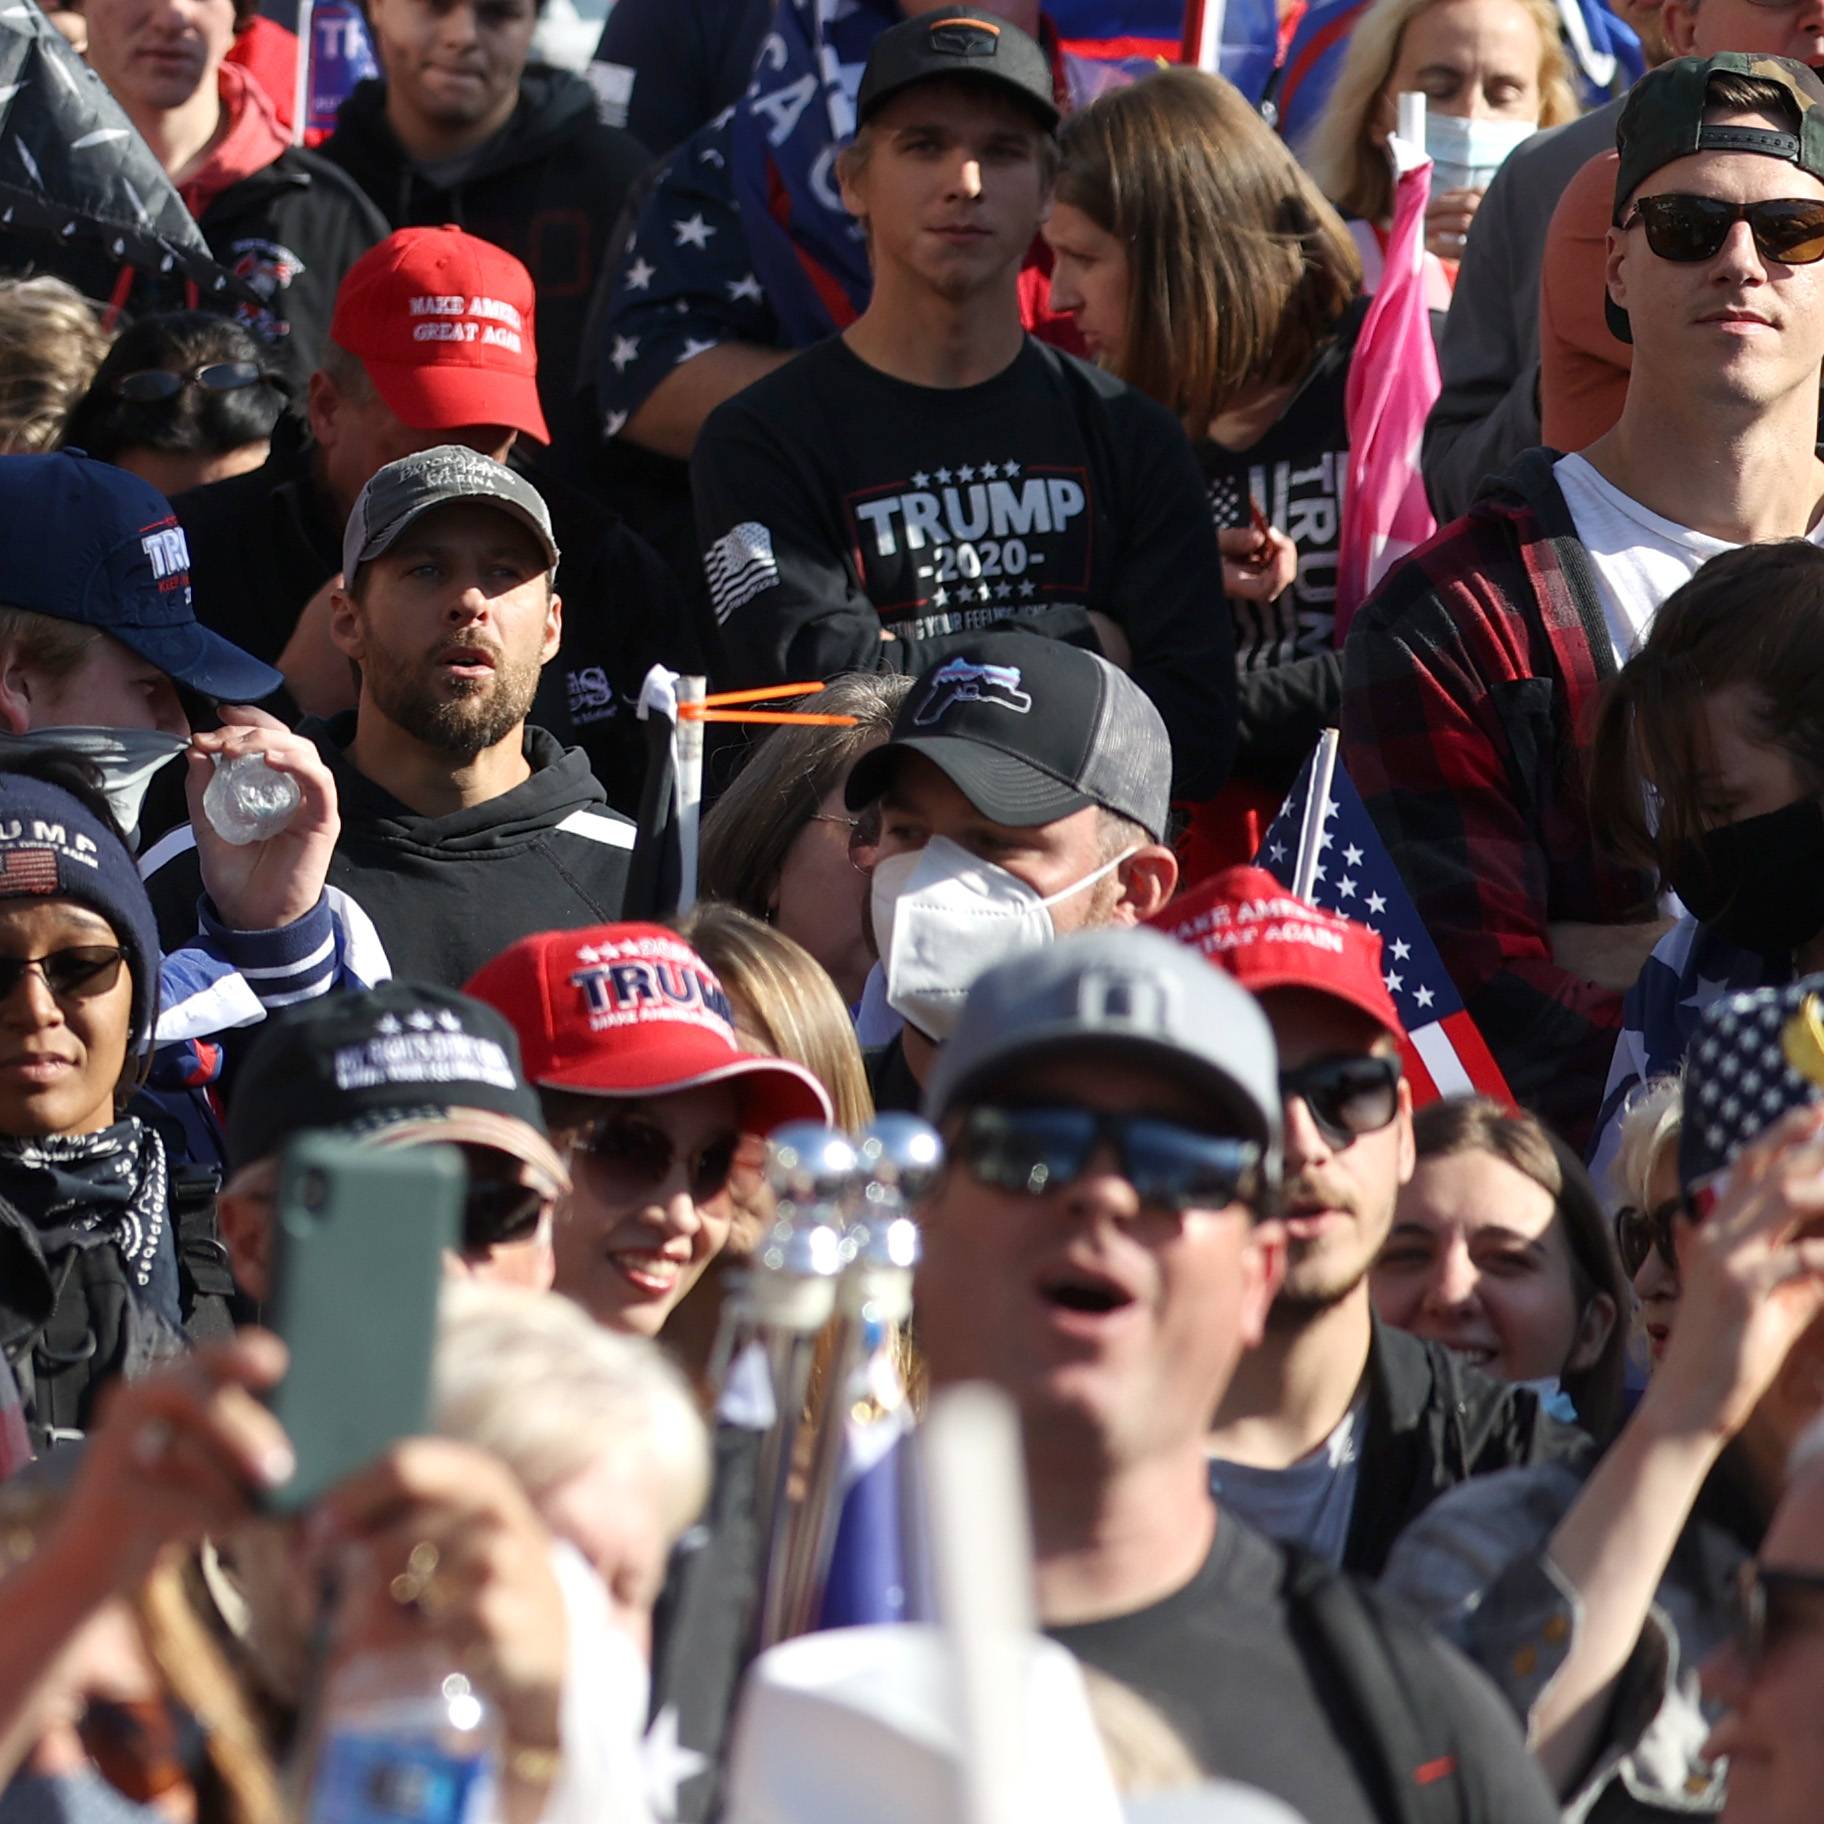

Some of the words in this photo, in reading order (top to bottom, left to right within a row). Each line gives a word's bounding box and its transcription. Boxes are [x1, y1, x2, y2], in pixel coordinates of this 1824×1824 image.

[409, 295, 465, 316] MAKE
[413, 322, 479, 342] GREAT
[857, 478, 1086, 557] TRUMP
